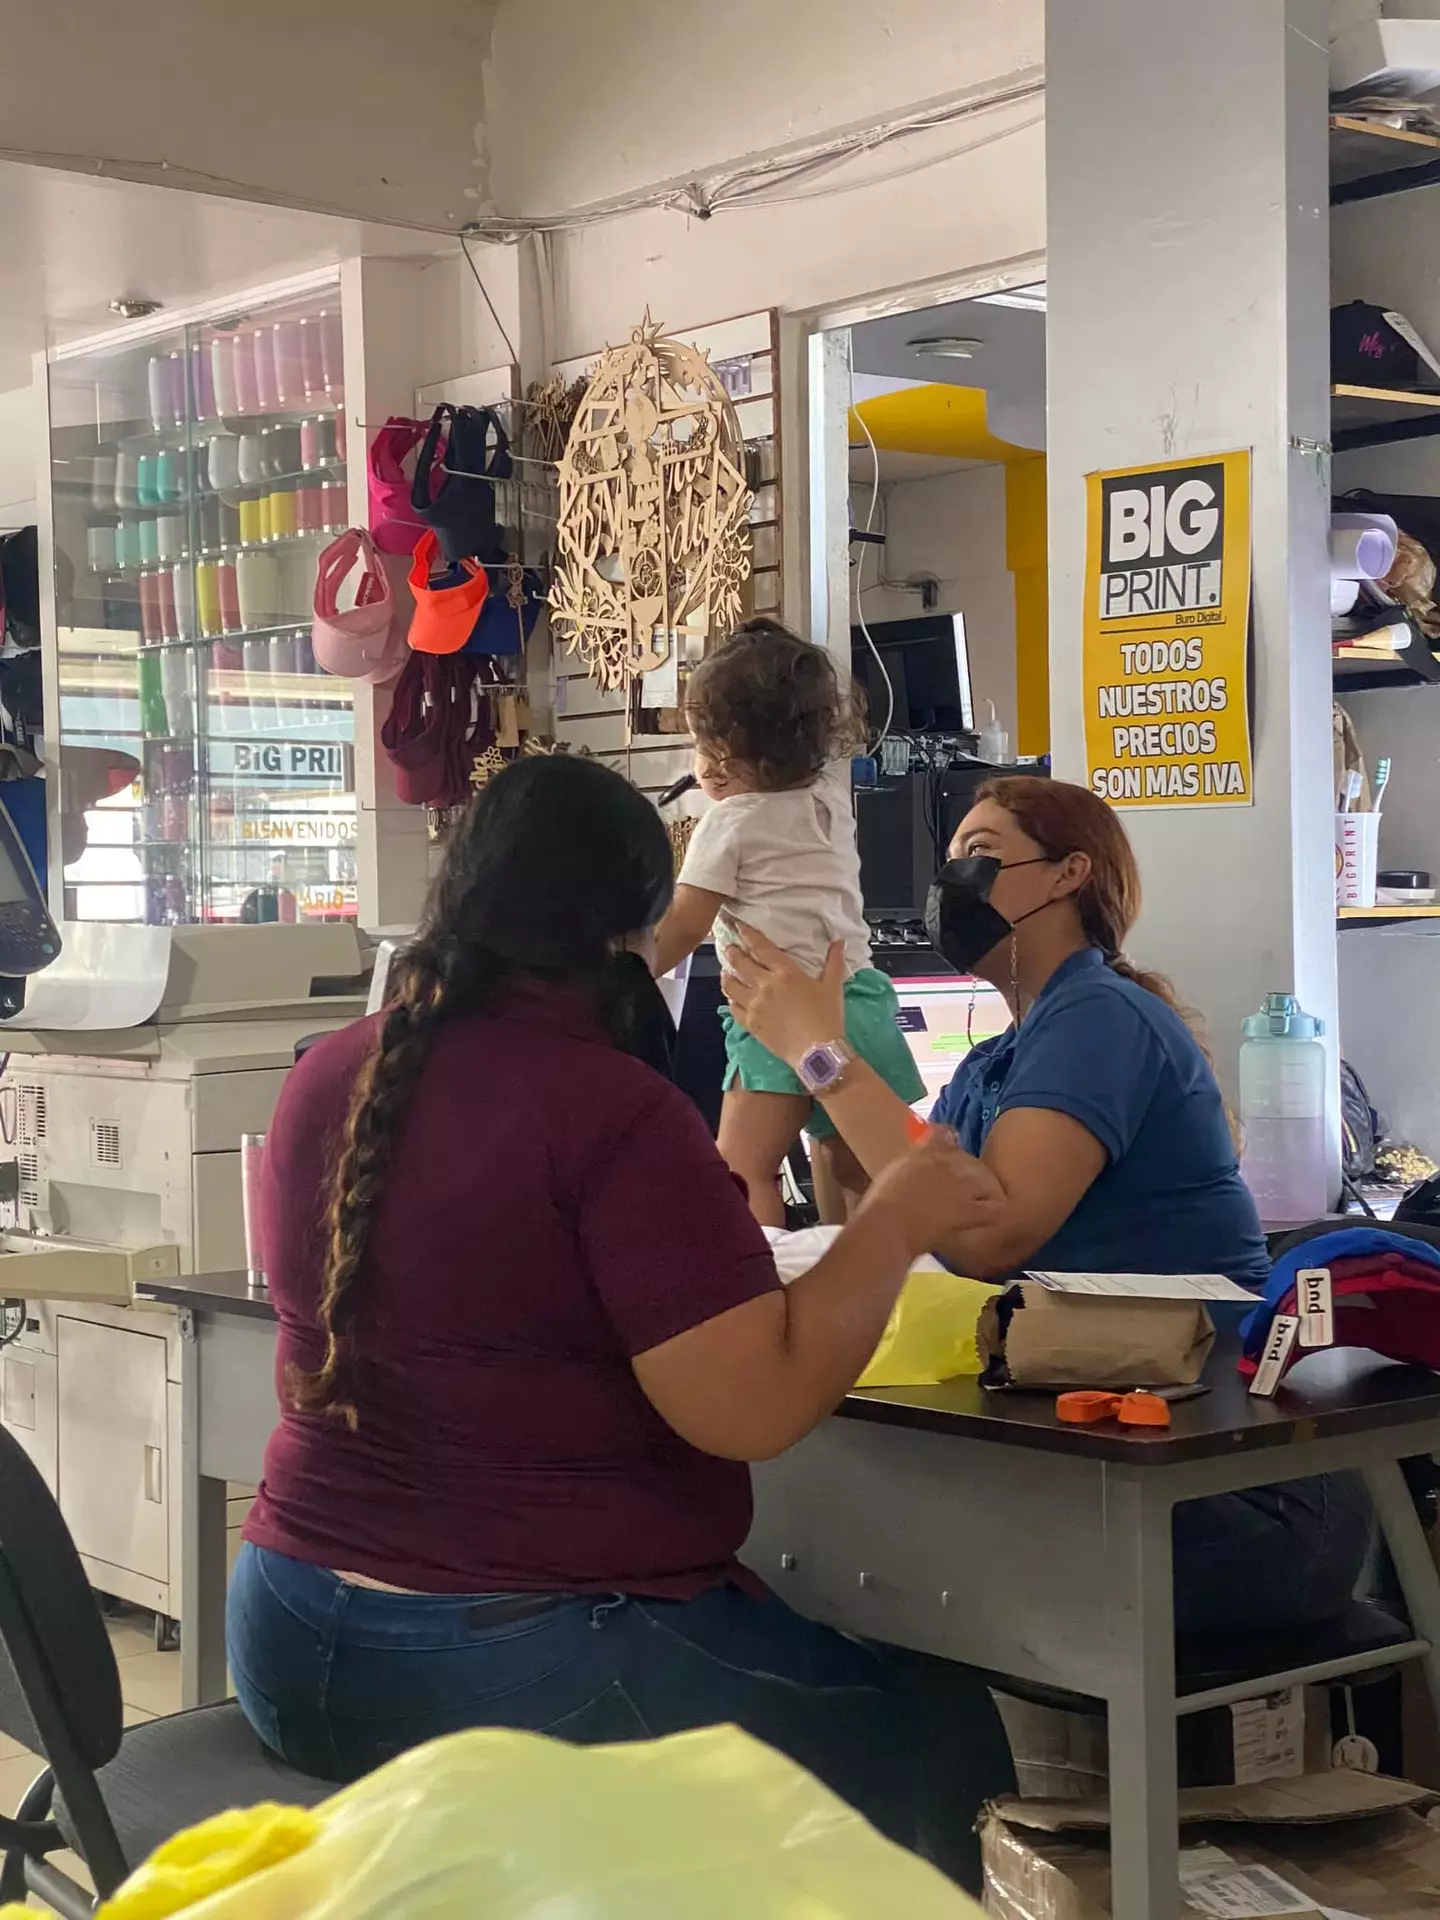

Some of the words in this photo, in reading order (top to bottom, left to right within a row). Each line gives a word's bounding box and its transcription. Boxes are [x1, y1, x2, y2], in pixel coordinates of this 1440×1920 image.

[1109, 479, 1219, 563] BIG
[1175, 613, 1196, 625] Buro
[1197, 610, 1222, 624] Digital
[1120, 637, 1204, 676] TODOS
[1098, 677, 1228, 718] NUESTROS
[234, 745, 281, 771] BIG
[1112, 720, 1218, 758] PRECIOS
[1092, 766, 1142, 800] SON
[1144, 763, 1200, 798] MAS
[1203, 761, 1246, 796] IVA
